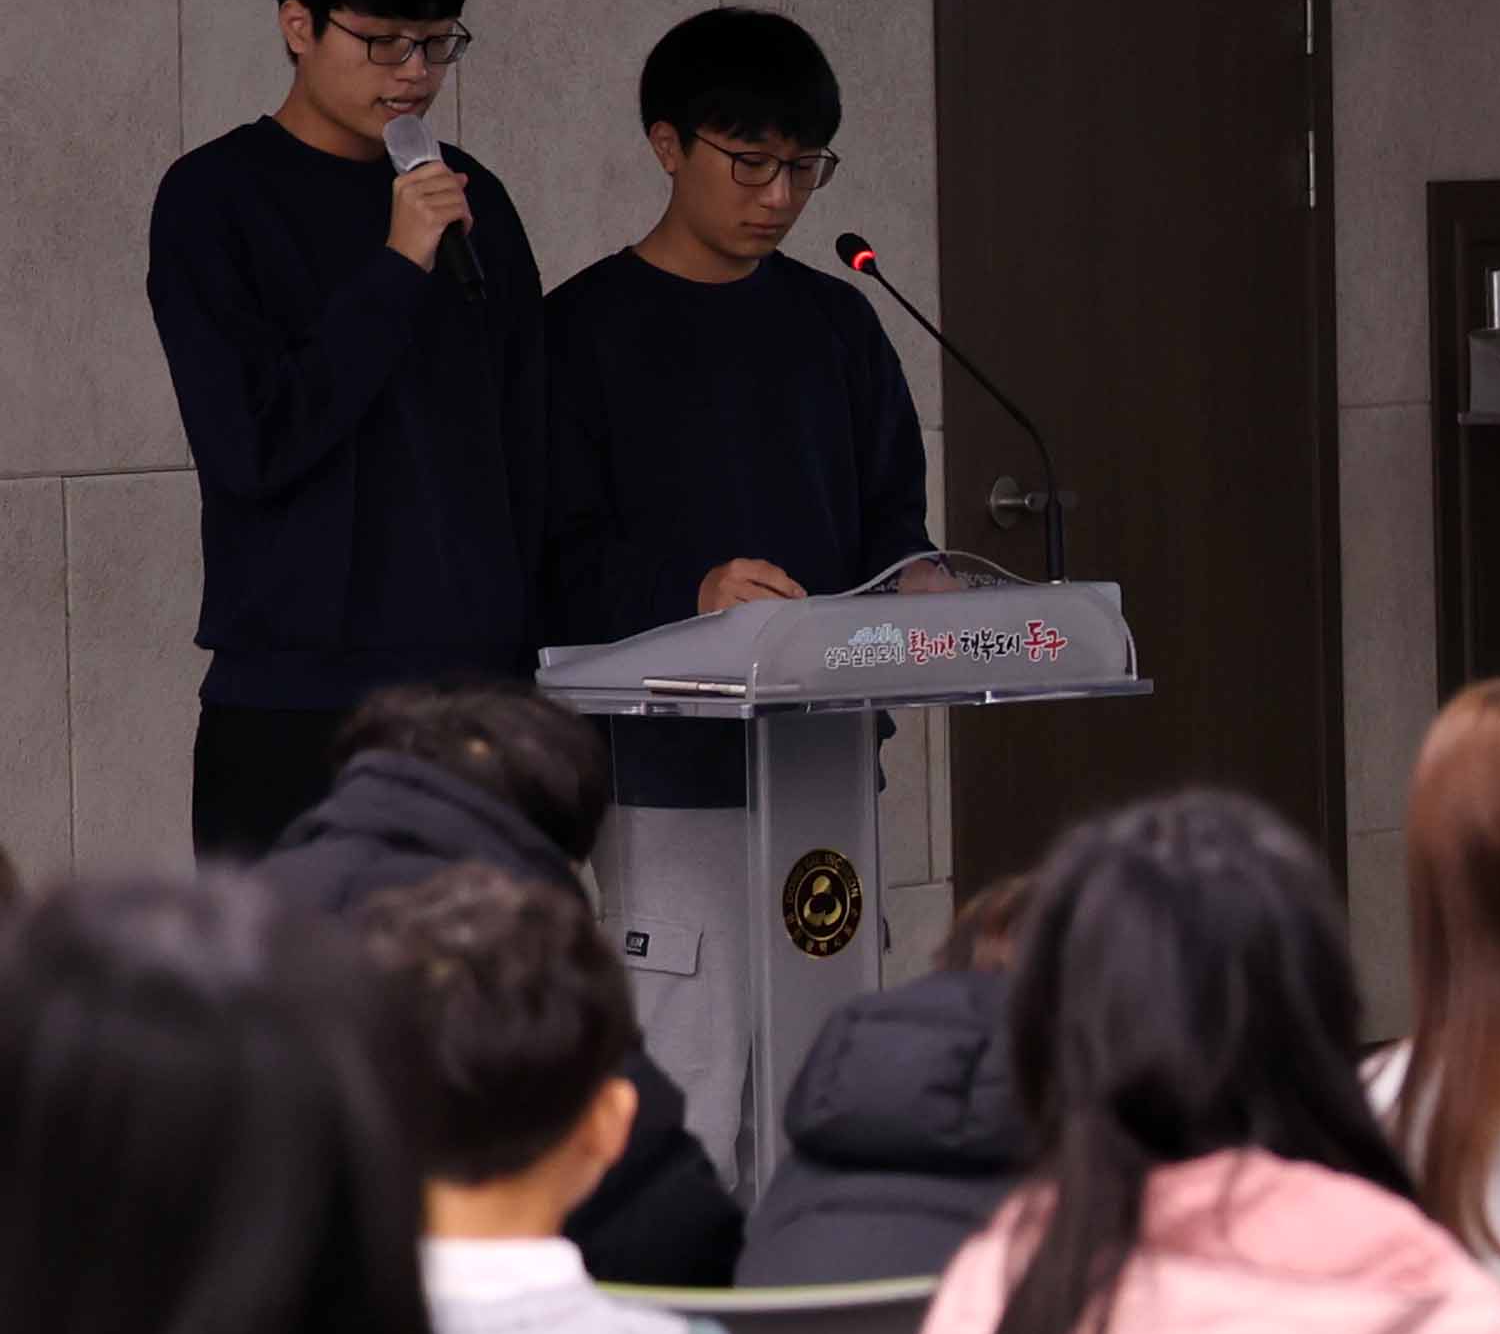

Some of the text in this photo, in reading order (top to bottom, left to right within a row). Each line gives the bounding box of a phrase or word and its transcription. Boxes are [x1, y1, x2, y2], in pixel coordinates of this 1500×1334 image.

[908, 628, 957, 665] 활기찬
[960, 627, 1022, 663] 행복도시
[1023, 620, 1069, 662] 동구
